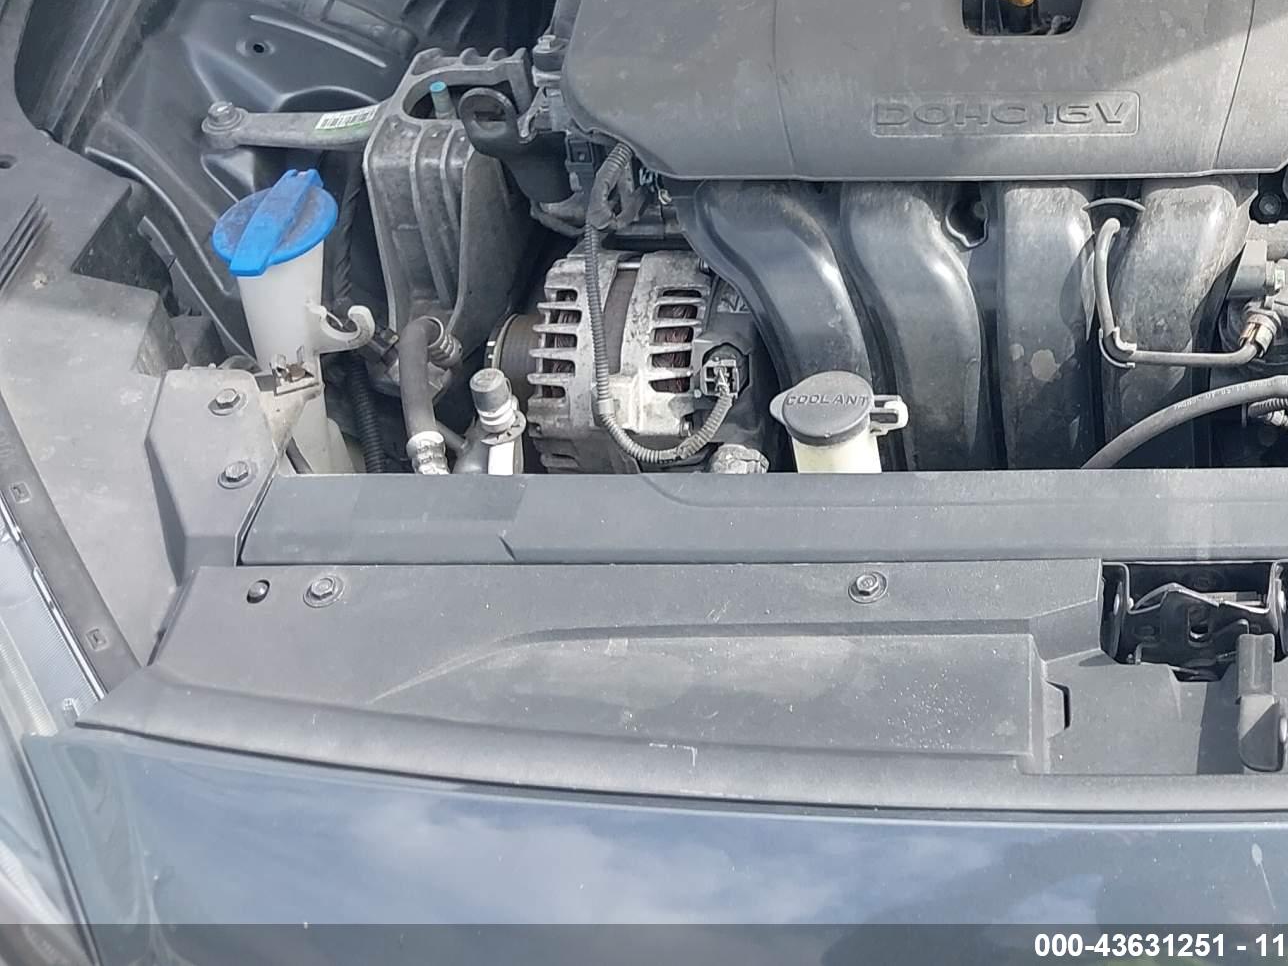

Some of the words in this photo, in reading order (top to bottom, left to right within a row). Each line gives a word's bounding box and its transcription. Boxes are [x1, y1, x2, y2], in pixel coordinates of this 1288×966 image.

[874, 102, 1028, 127] DOHC
[1043, 101, 1132, 125] 16V
[785, 394, 869, 408] COOLANT
